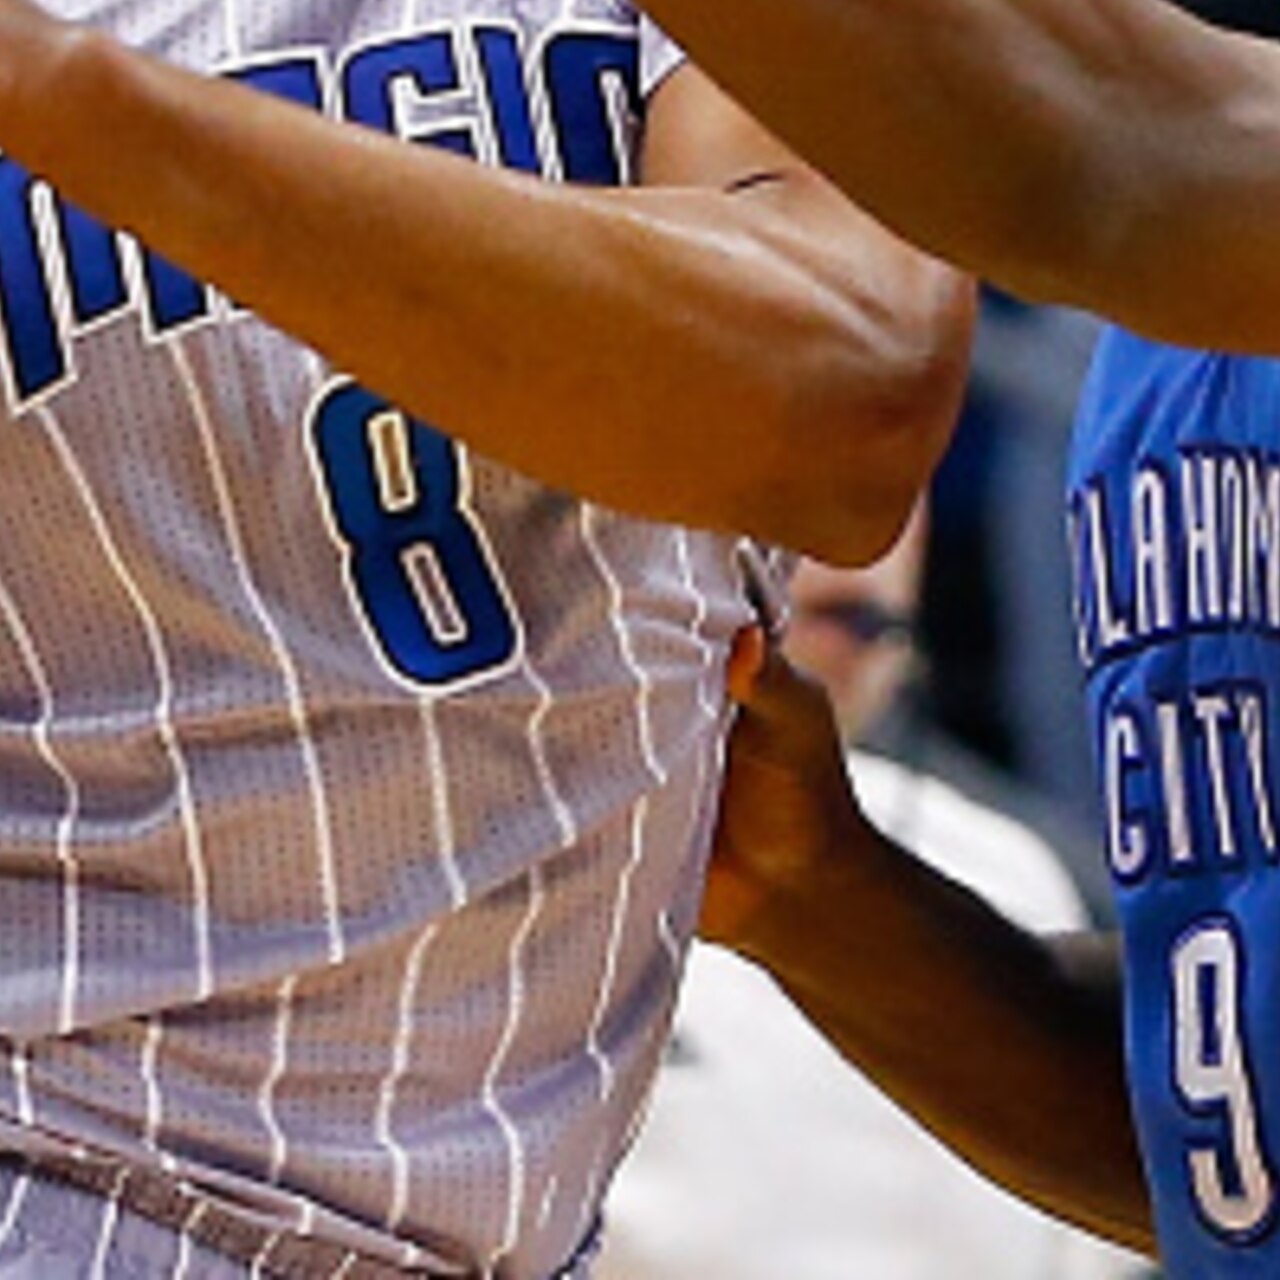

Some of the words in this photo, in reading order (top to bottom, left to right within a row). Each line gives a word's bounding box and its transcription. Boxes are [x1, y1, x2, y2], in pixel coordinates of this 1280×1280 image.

[304, 375, 524, 697] 8
[1102, 690, 1280, 878] CITY
[1169, 920, 1280, 1238] 9
